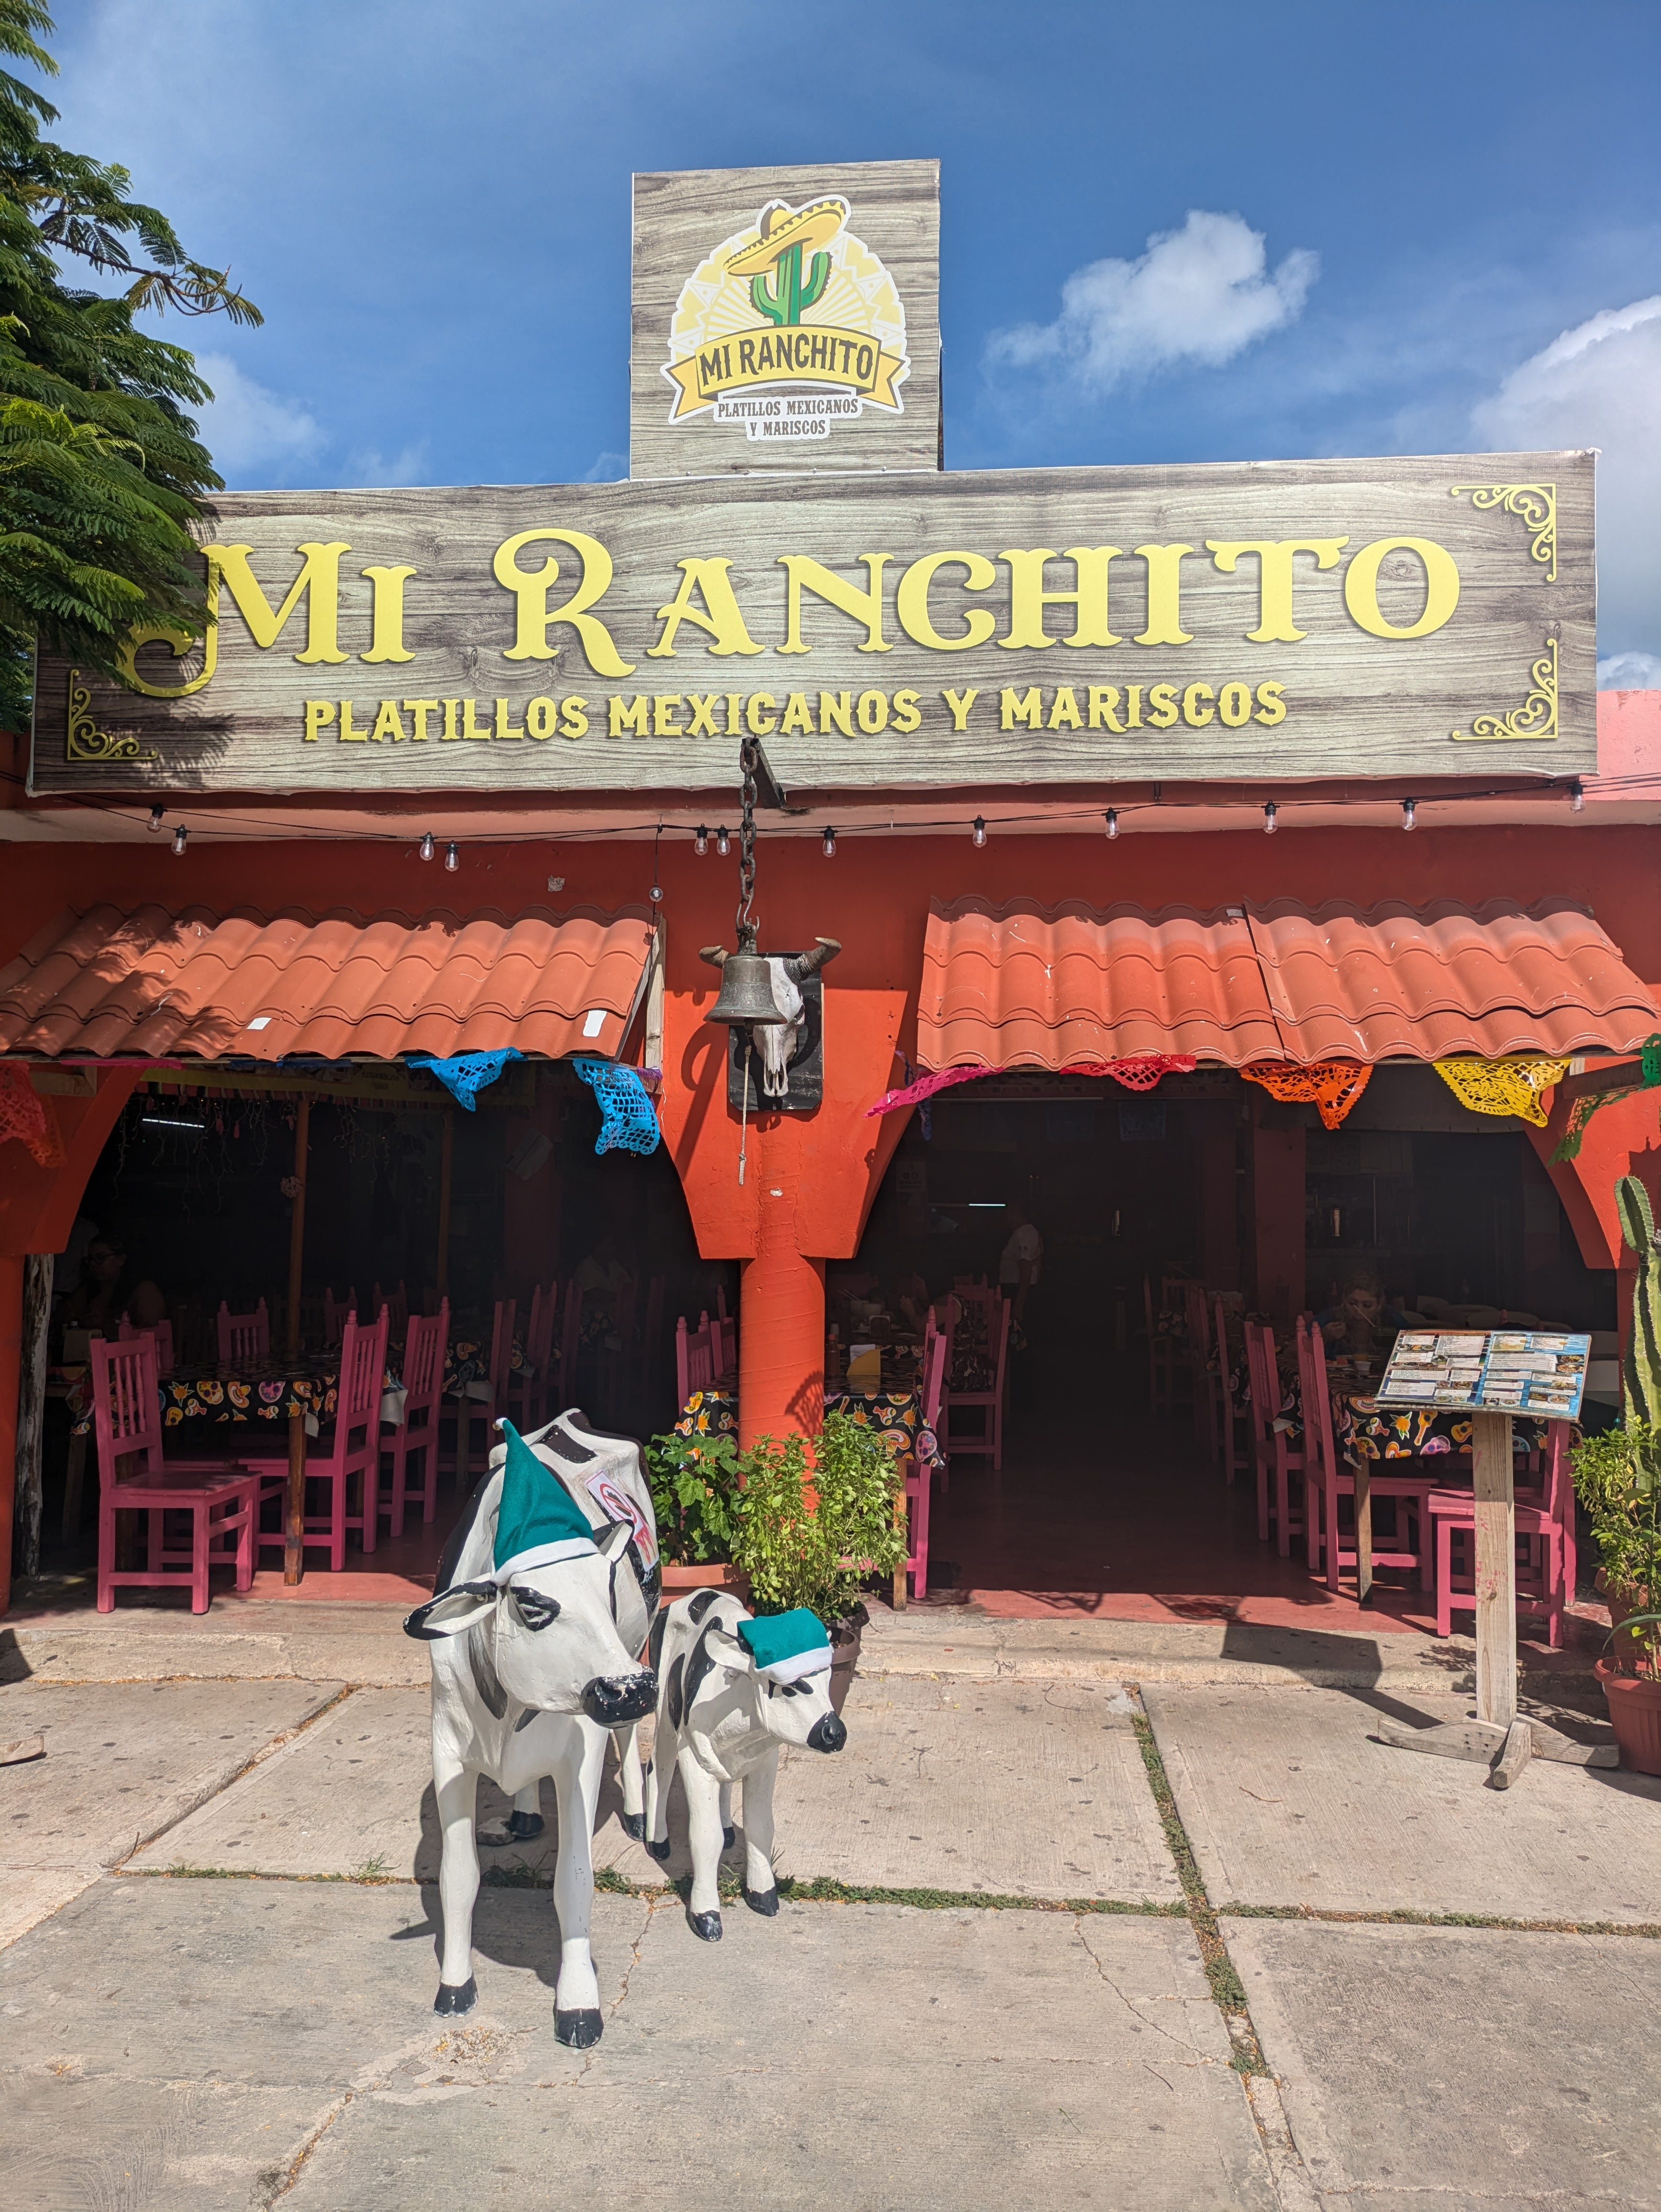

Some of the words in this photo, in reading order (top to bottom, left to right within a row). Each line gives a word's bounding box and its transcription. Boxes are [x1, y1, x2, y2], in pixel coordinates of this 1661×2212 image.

[699, 343, 732, 387] MI
[739, 332, 873, 380] RANCHITO
[718, 400, 781, 417] PLATILLOS
[786, 398, 859, 415] MEXICANOS
[749, 421, 757, 437] Y
[763, 419, 826, 436] MARISCOS
[115, 542, 417, 697] MI
[493, 528, 1460, 677] RANCHITO
[304, 696, 589, 741] PLATILLOS
[608, 688, 922, 737] MEXICANOS
[942, 688, 979, 730] Y
[1000, 681, 1287, 733] MARISCOS
